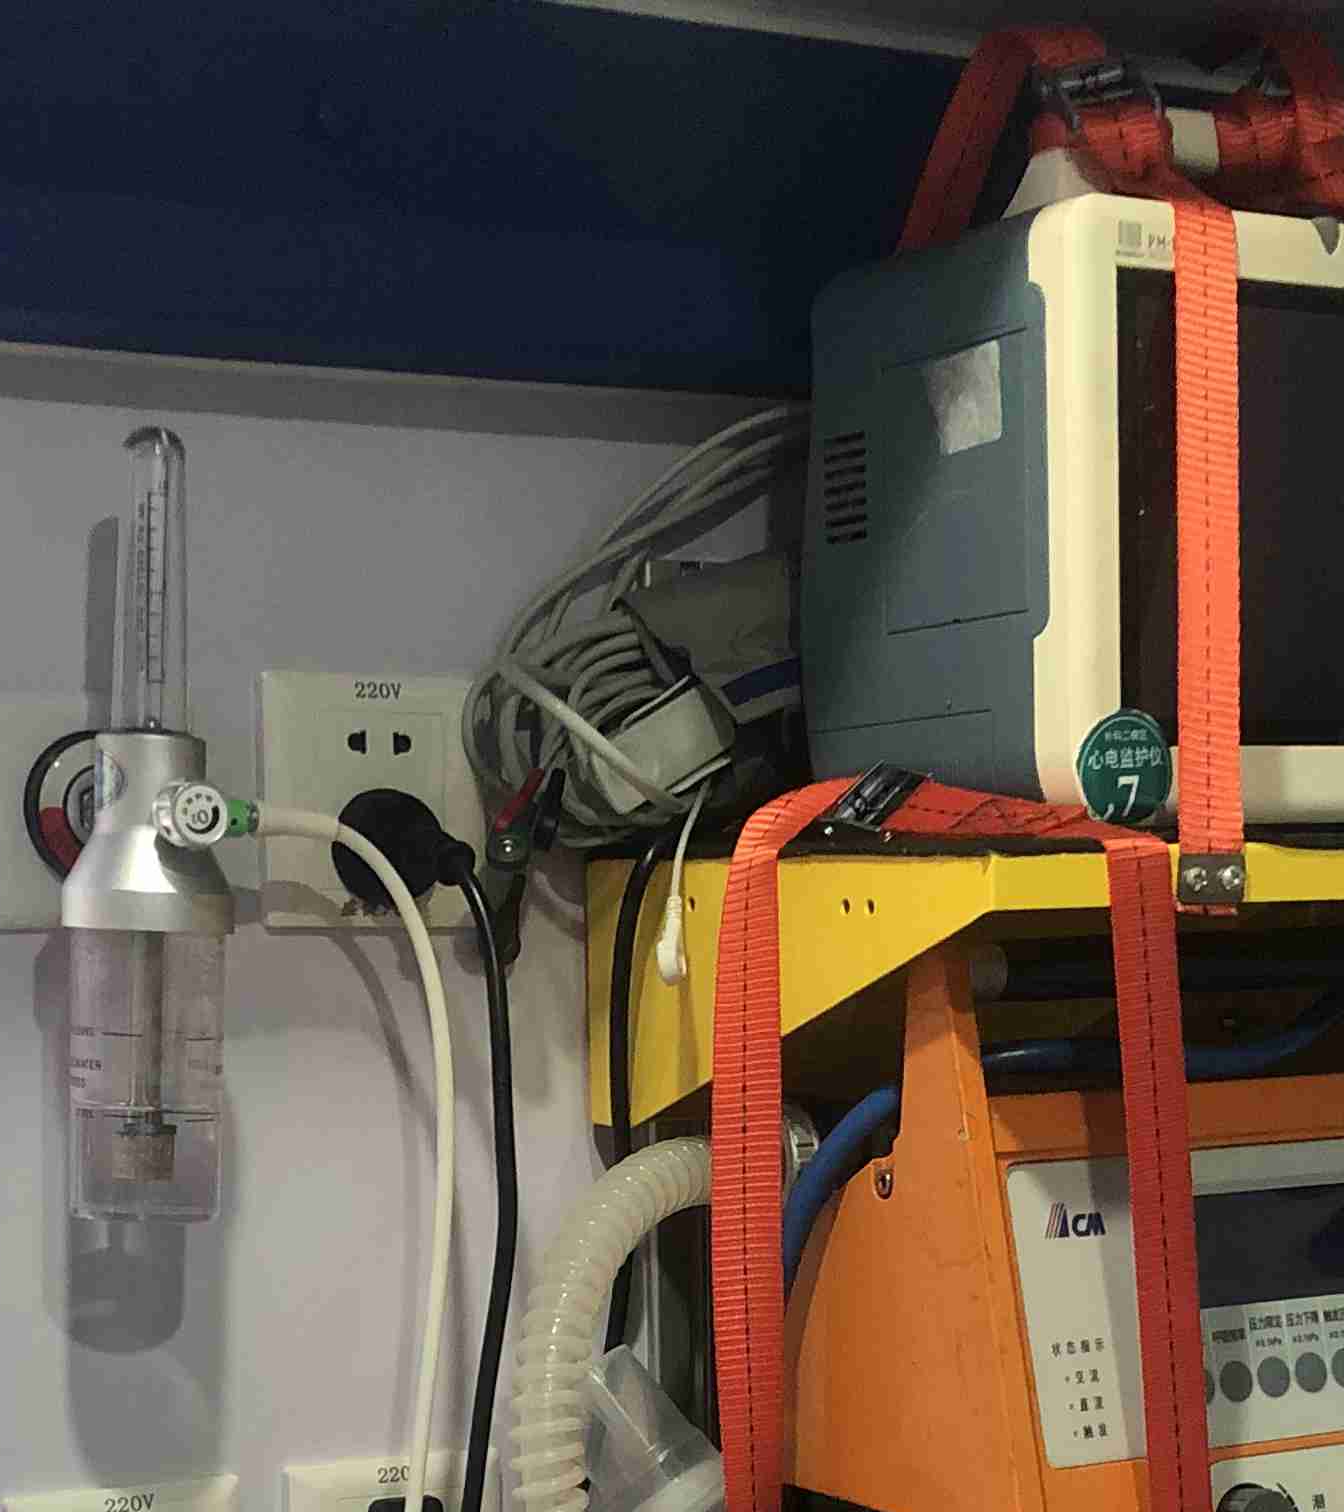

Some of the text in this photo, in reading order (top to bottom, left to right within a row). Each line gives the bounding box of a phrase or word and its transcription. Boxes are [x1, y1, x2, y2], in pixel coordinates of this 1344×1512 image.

[354, 682, 401, 701] 220V
[1087, 745, 1165, 770] 心电监护仪
[377, 1466, 410, 1485] 220
